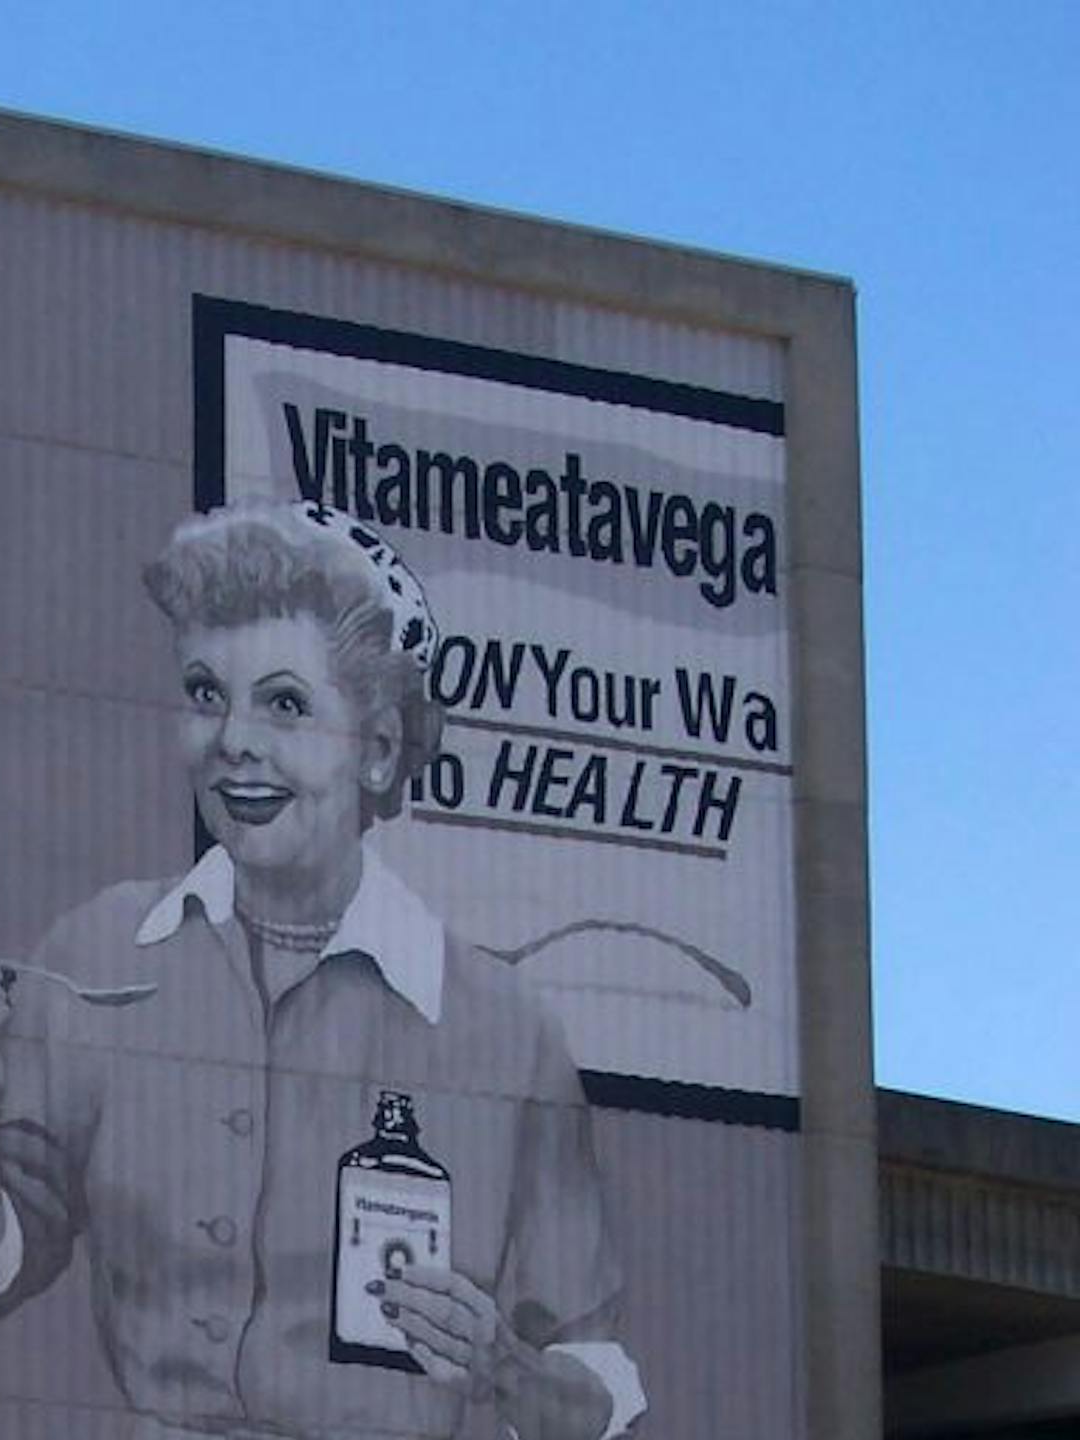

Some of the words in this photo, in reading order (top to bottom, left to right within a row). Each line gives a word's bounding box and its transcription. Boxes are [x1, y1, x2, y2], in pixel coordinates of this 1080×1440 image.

[283, 403, 777, 606] Vitameatavega
[431, 636, 524, 708] ON
[529, 644, 660, 731] Your
[674, 668, 777, 751] Wa
[487, 741, 742, 841] HEALTH
